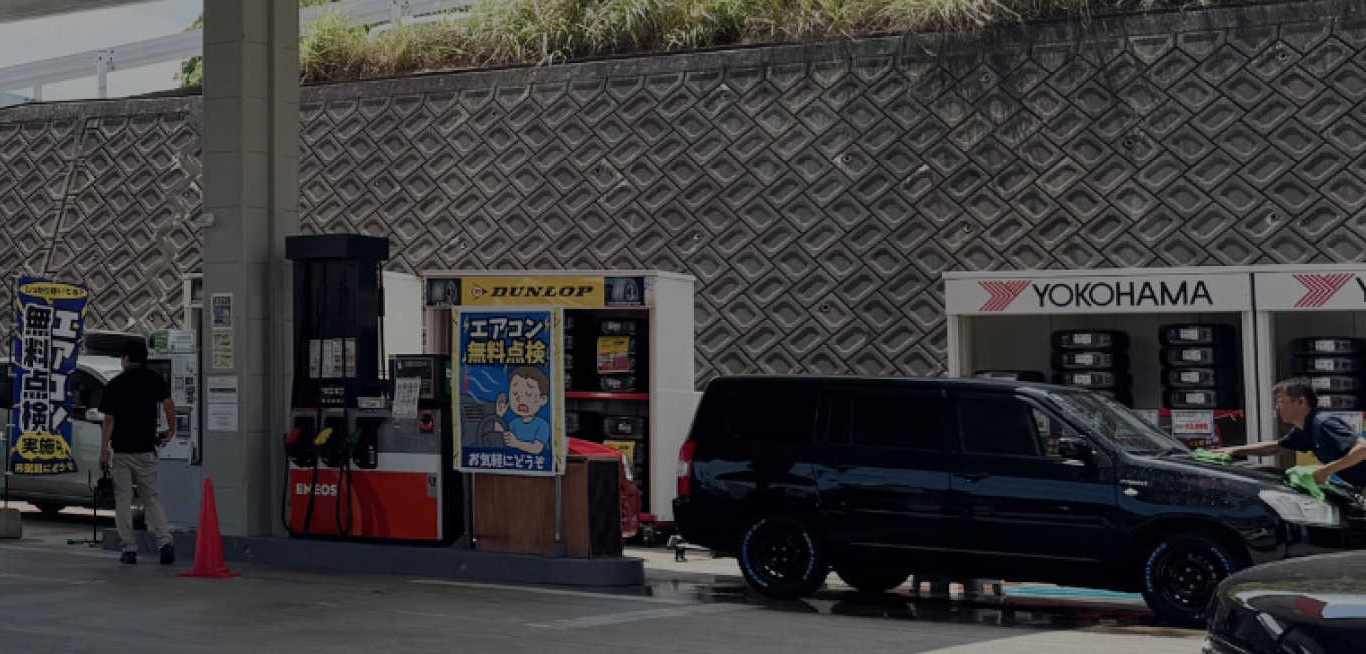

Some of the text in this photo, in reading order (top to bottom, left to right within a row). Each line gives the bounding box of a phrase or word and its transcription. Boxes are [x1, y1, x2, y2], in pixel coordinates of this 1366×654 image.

[490, 286, 594, 297] DUNLOP
[1032, 281, 1214, 307] YOKOHAMA
[470, 317, 544, 339] エアコン
[465, 341, 547, 364] 無料点検
[22, 305, 51, 432] 無料点検
[50, 309, 79, 431] エアコン
[468, 453, 545, 470] お気軽にどうぞ
[295, 482, 337, 496] ENEOS
